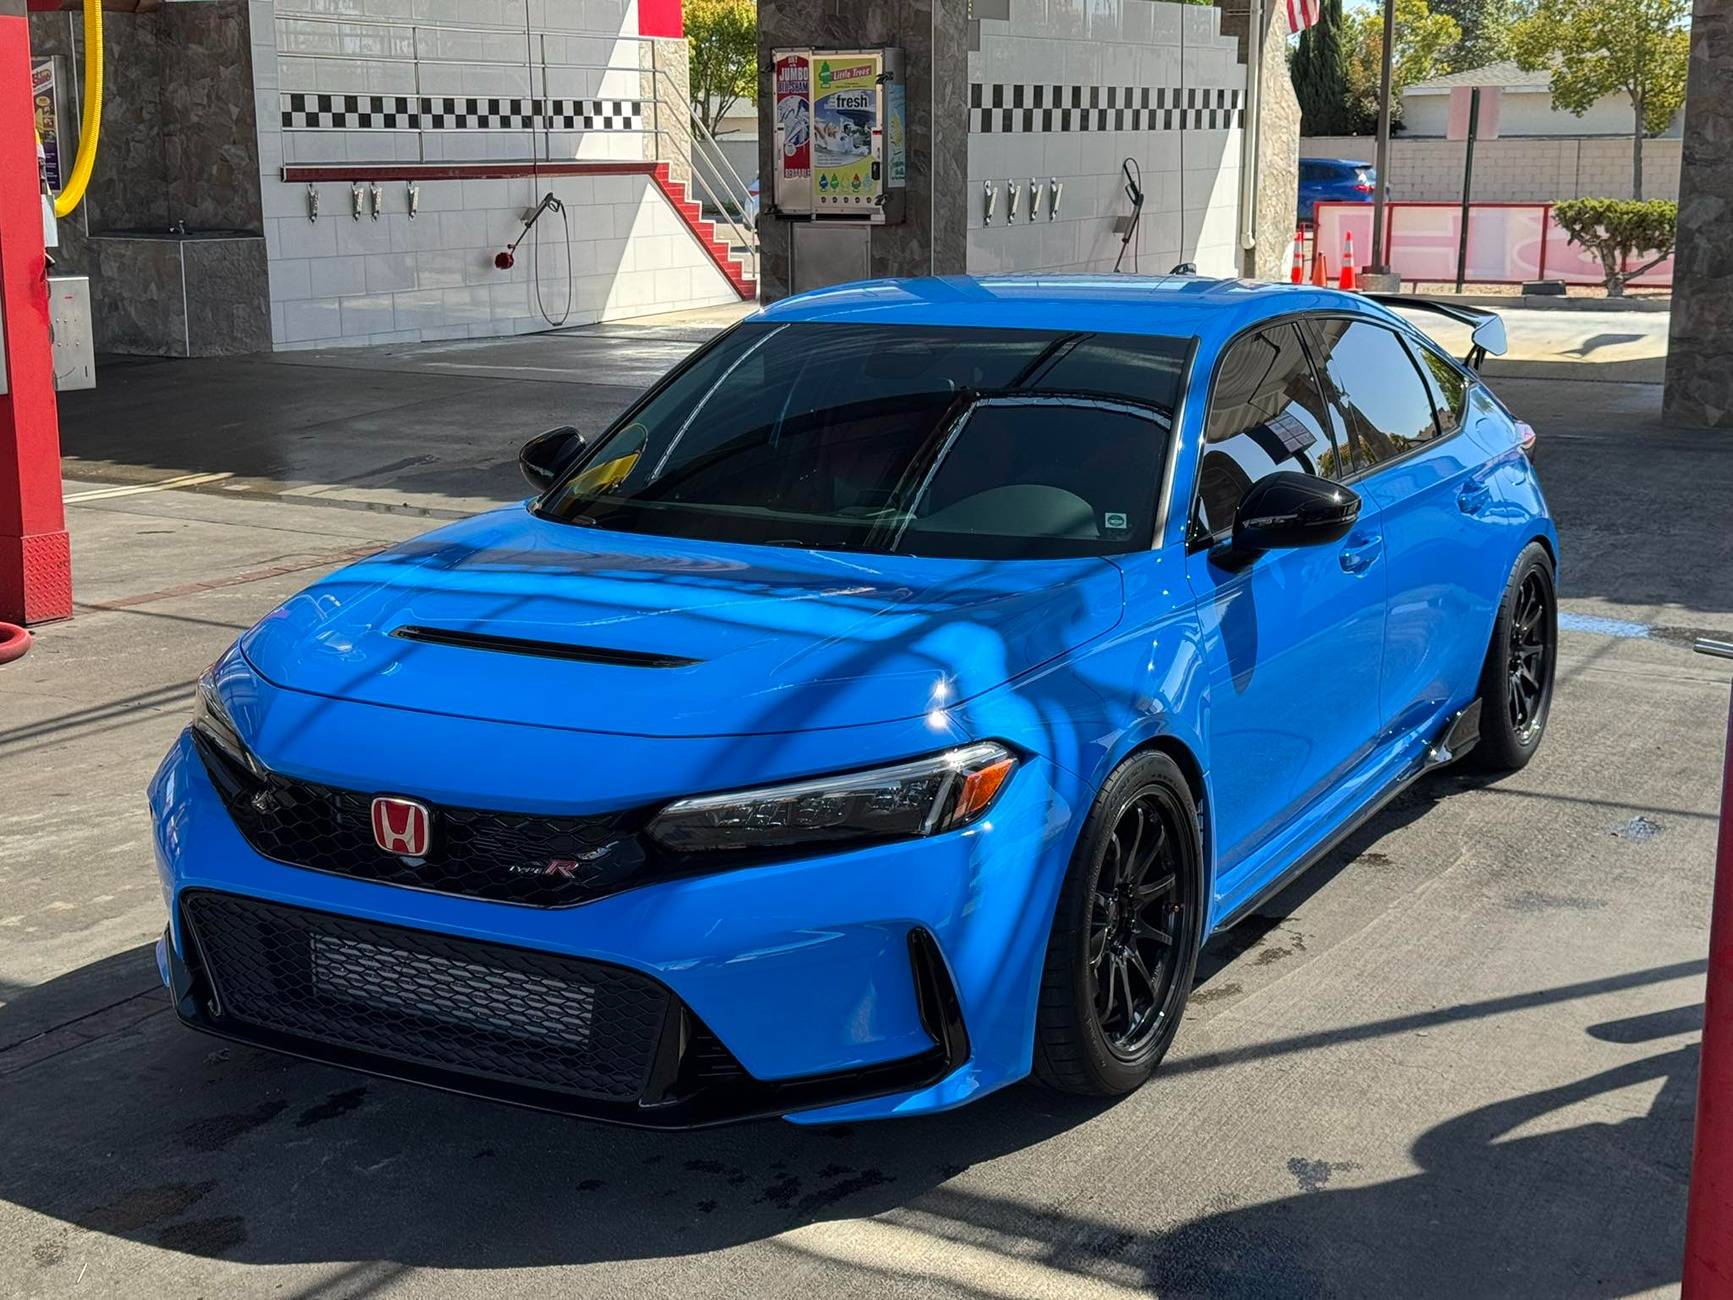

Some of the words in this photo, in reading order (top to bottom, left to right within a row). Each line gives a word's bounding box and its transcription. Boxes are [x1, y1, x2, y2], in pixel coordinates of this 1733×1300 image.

[779, 67, 809, 81] JUMBO
[833, 69, 851, 80] Little
[853, 67, 870, 77] Trees
[836, 94, 867, 108] fresh
[381, 801, 416, 853] H
